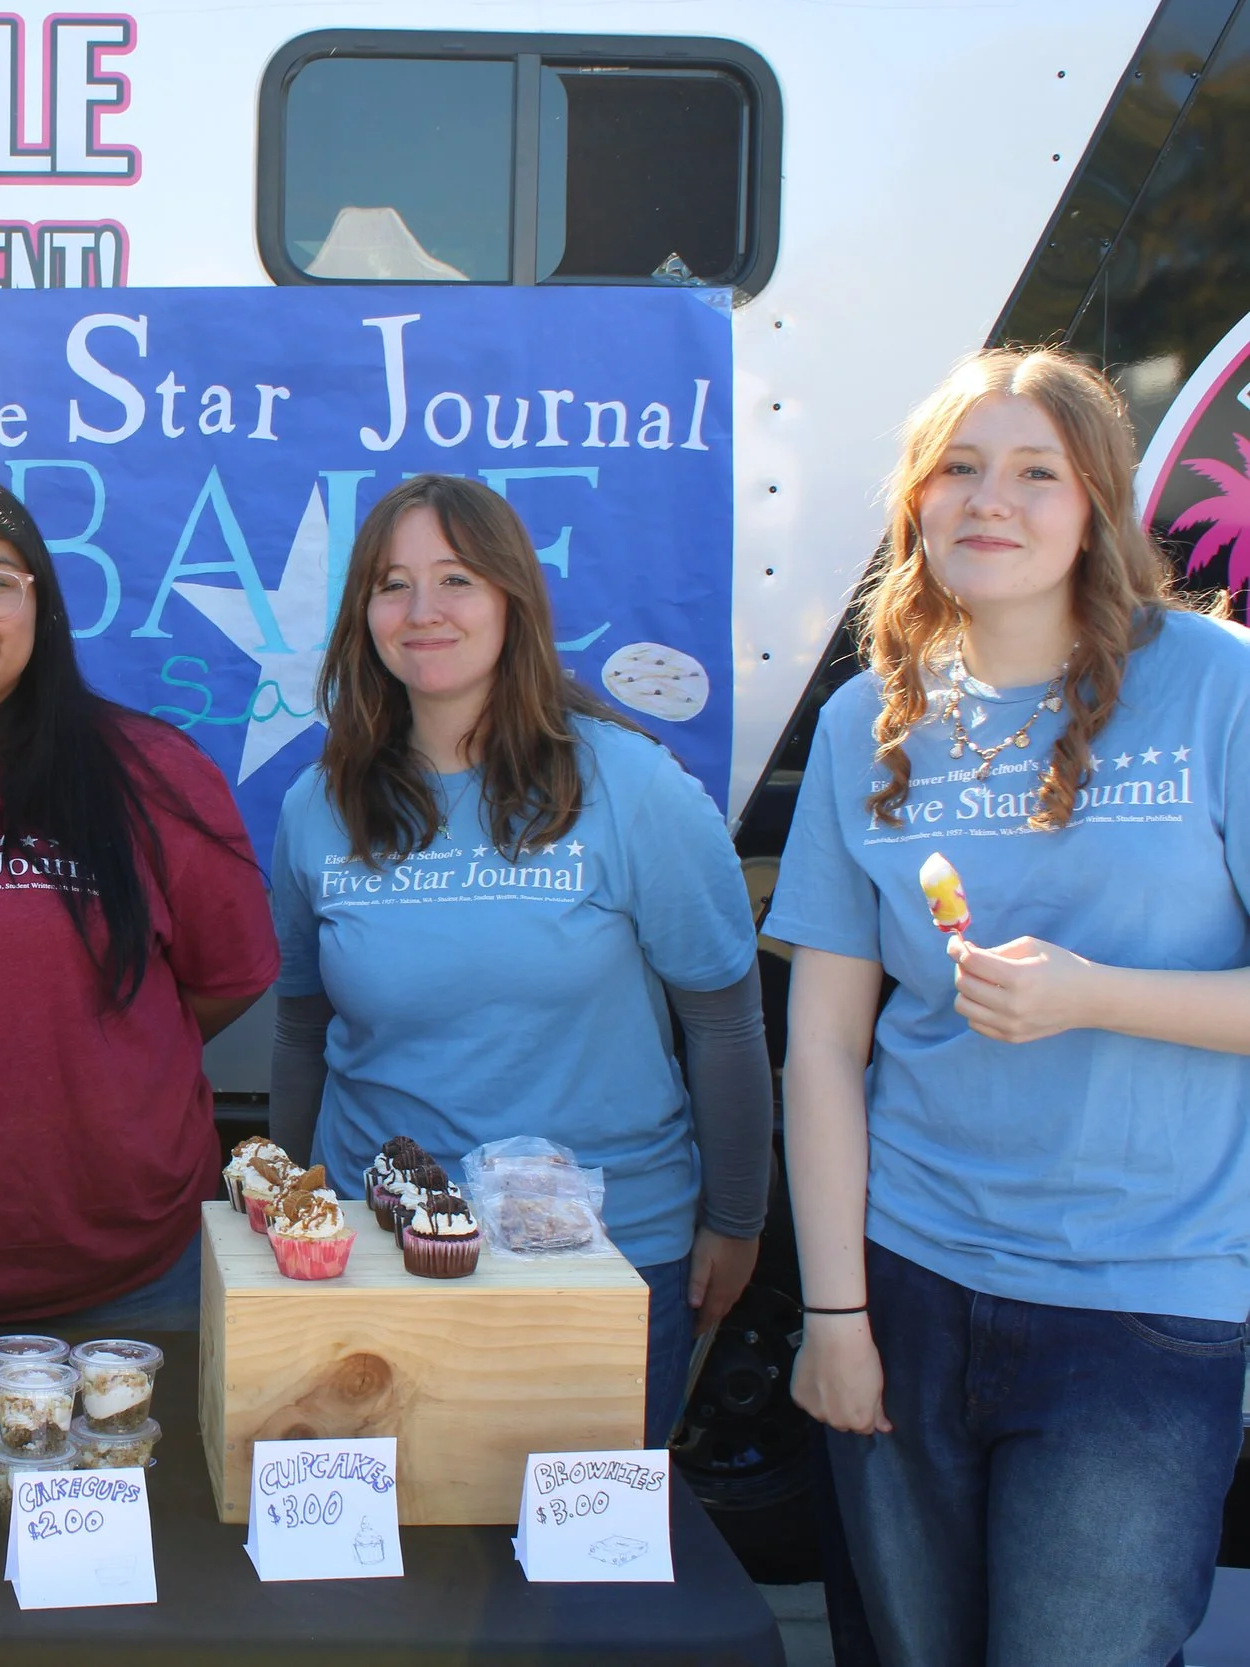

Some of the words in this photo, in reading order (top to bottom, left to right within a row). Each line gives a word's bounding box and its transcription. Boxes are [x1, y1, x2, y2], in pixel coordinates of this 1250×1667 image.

[65, 311, 291, 445] Star
[359, 313, 711, 452] Journal
[149, 655, 319, 731] Sa
[871, 774, 945, 793] Eisower
[956, 786, 1034, 820] Star
[1072, 767, 1193, 812] ournal
[324, 851, 384, 865] Eiseer
[388, 849, 415, 860] Hih
[416, 848, 463, 861] School's
[5, 882, 30, 890] Student
[321, 870, 382, 899] Five
[391, 865, 455, 892] Star
[461, 861, 585, 892] Journal
[259, 1451, 395, 1496] CUPCAKES
[533, 1460, 666, 1495] BROWNIES
[18, 1475, 141, 1513] CAKECUPS
[267, 1490, 344, 1529] $3.00
[535, 1489, 610, 1526] $3.00
[27, 1508, 105, 1541] $2.00
